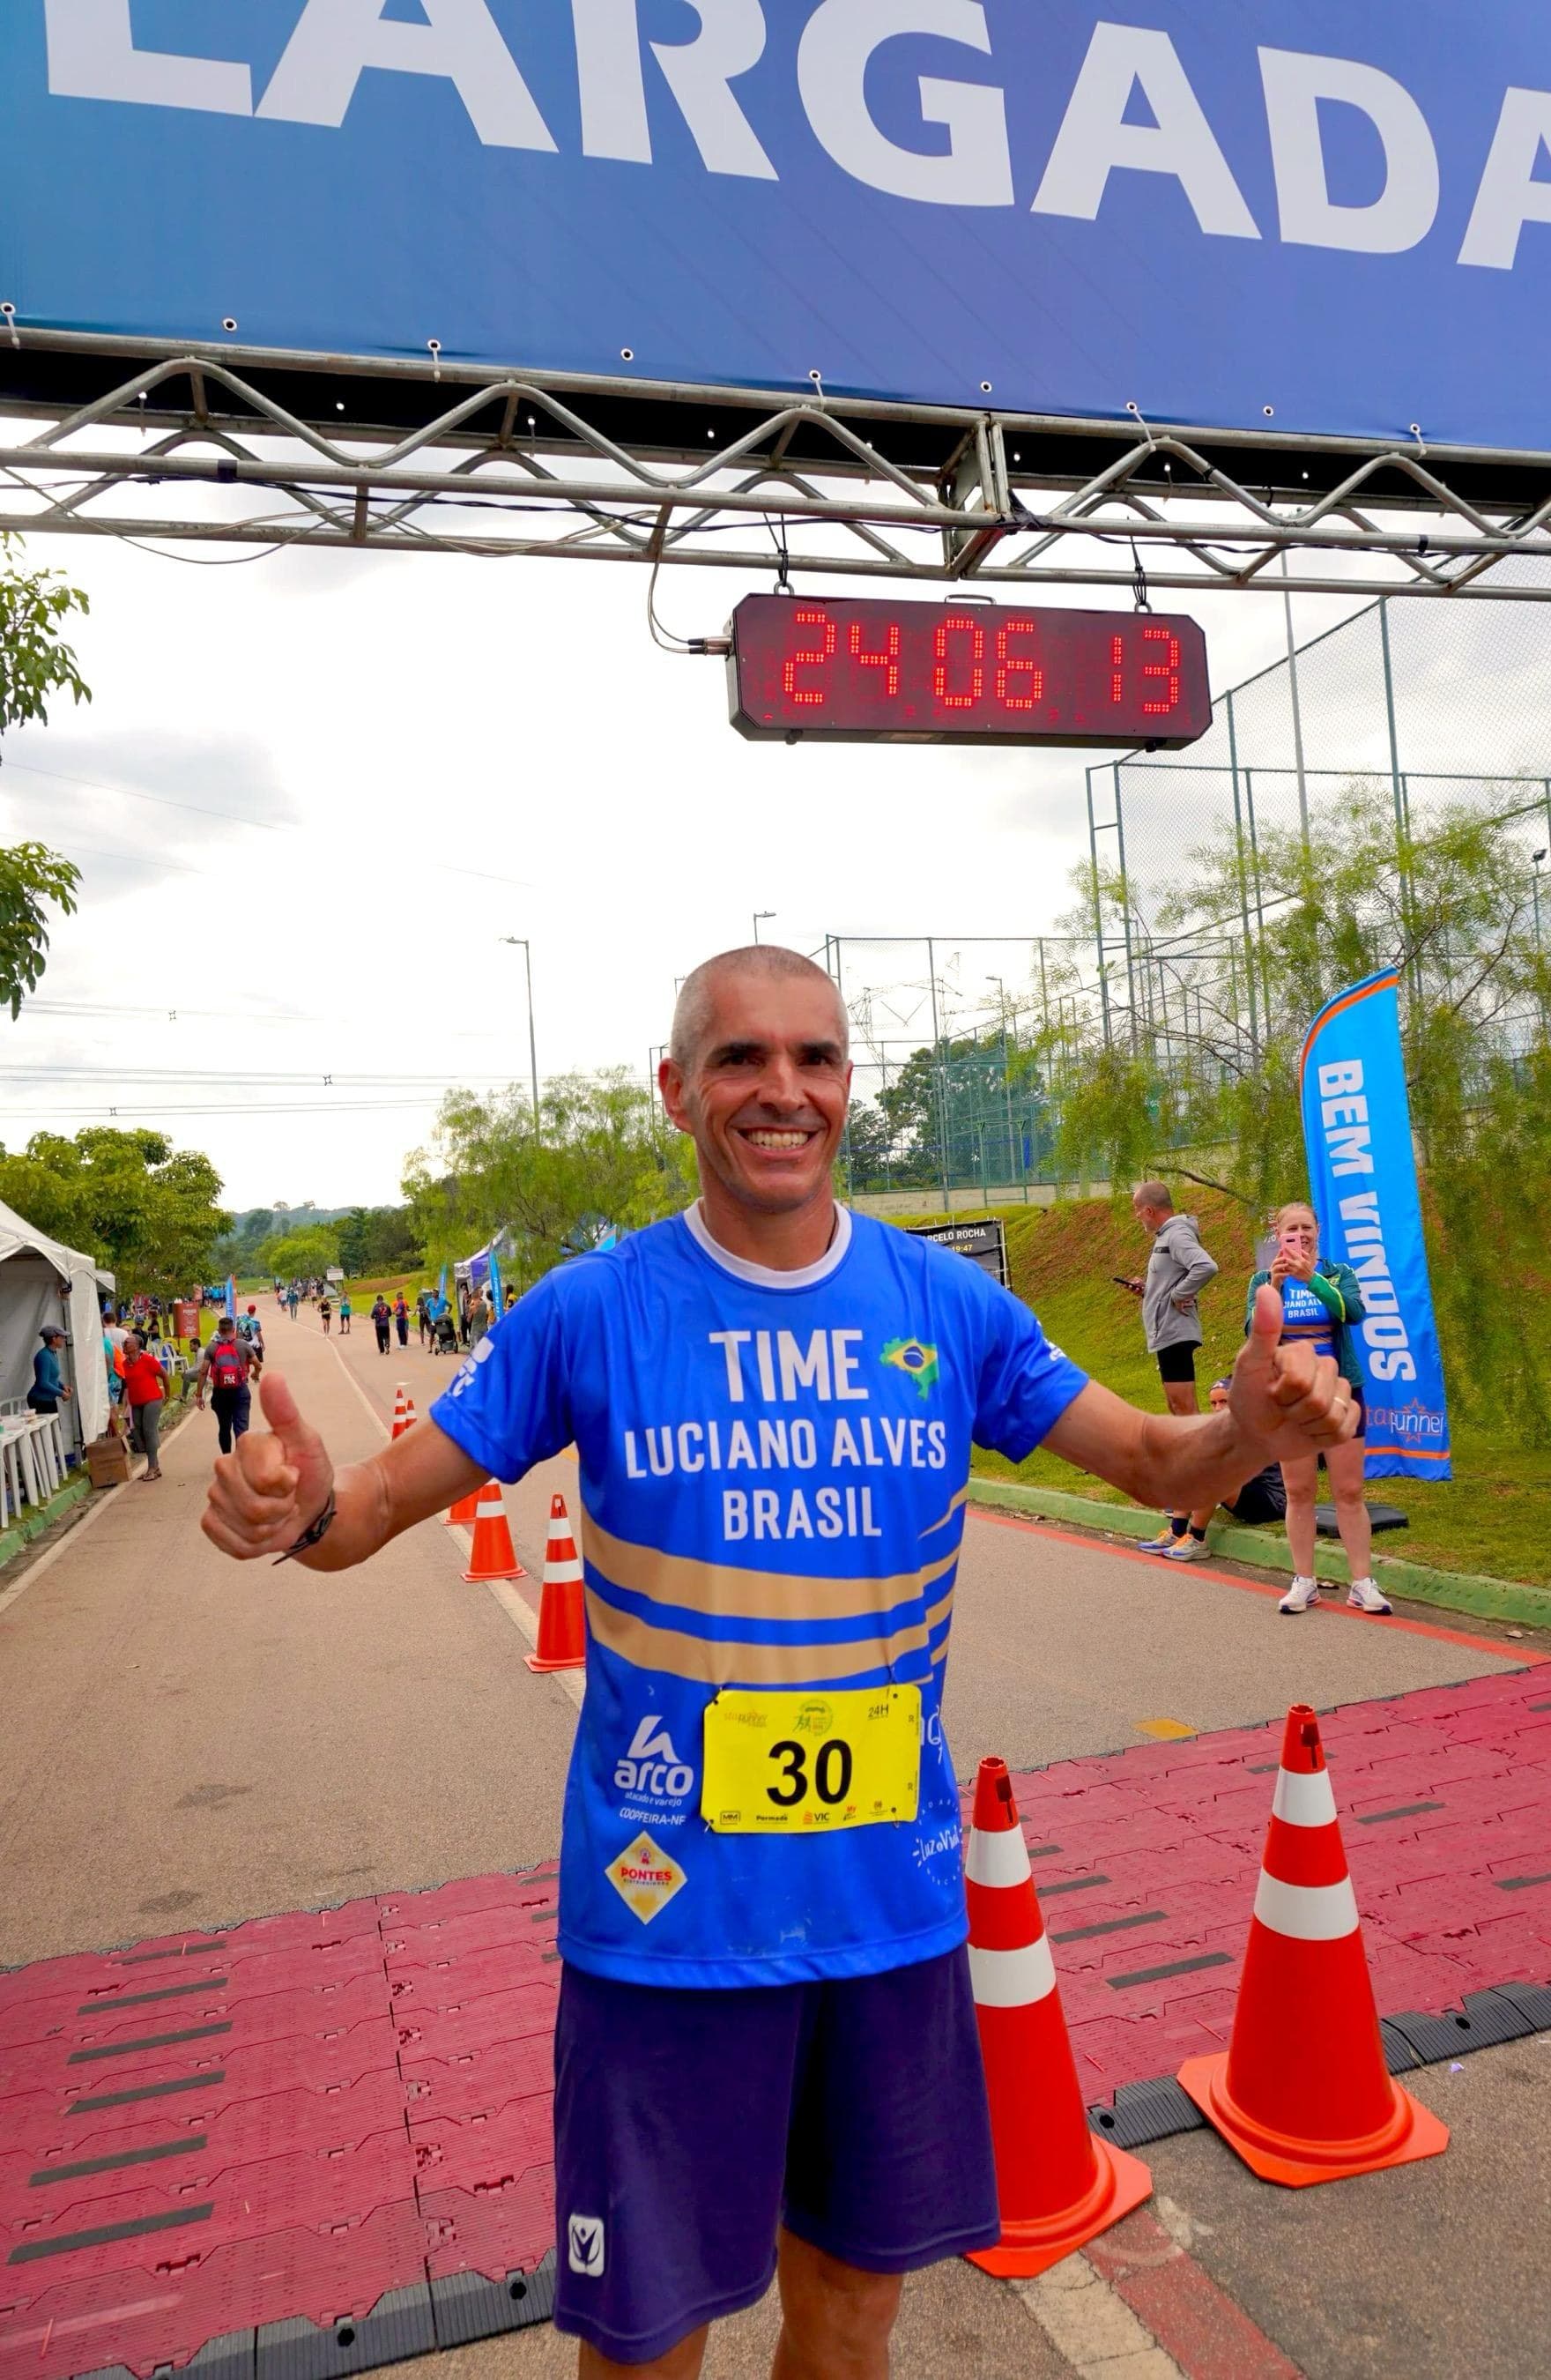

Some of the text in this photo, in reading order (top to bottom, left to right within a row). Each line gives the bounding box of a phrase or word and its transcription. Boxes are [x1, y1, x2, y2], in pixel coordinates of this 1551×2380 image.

[783, 613, 1178, 713] 24 06 13
[956, 1228, 986, 1239] ROCHA
[1318, 1060, 1417, 1381] BEM VINDOS
[1288, 1308, 1318, 1319] BRASIL
[709, 1329, 869, 1402] TIME
[624, 1417, 946, 1479] LUCIANO ALVES
[723, 1486, 882, 1541] BRASIL
[614, 1759, 694, 1796] arco
[767, 1739, 852, 1806] 30
[655, 1796, 682, 1808] varejo
[814, 1812, 829, 1821] VIC
[620, 1866, 672, 1882] PONTES
